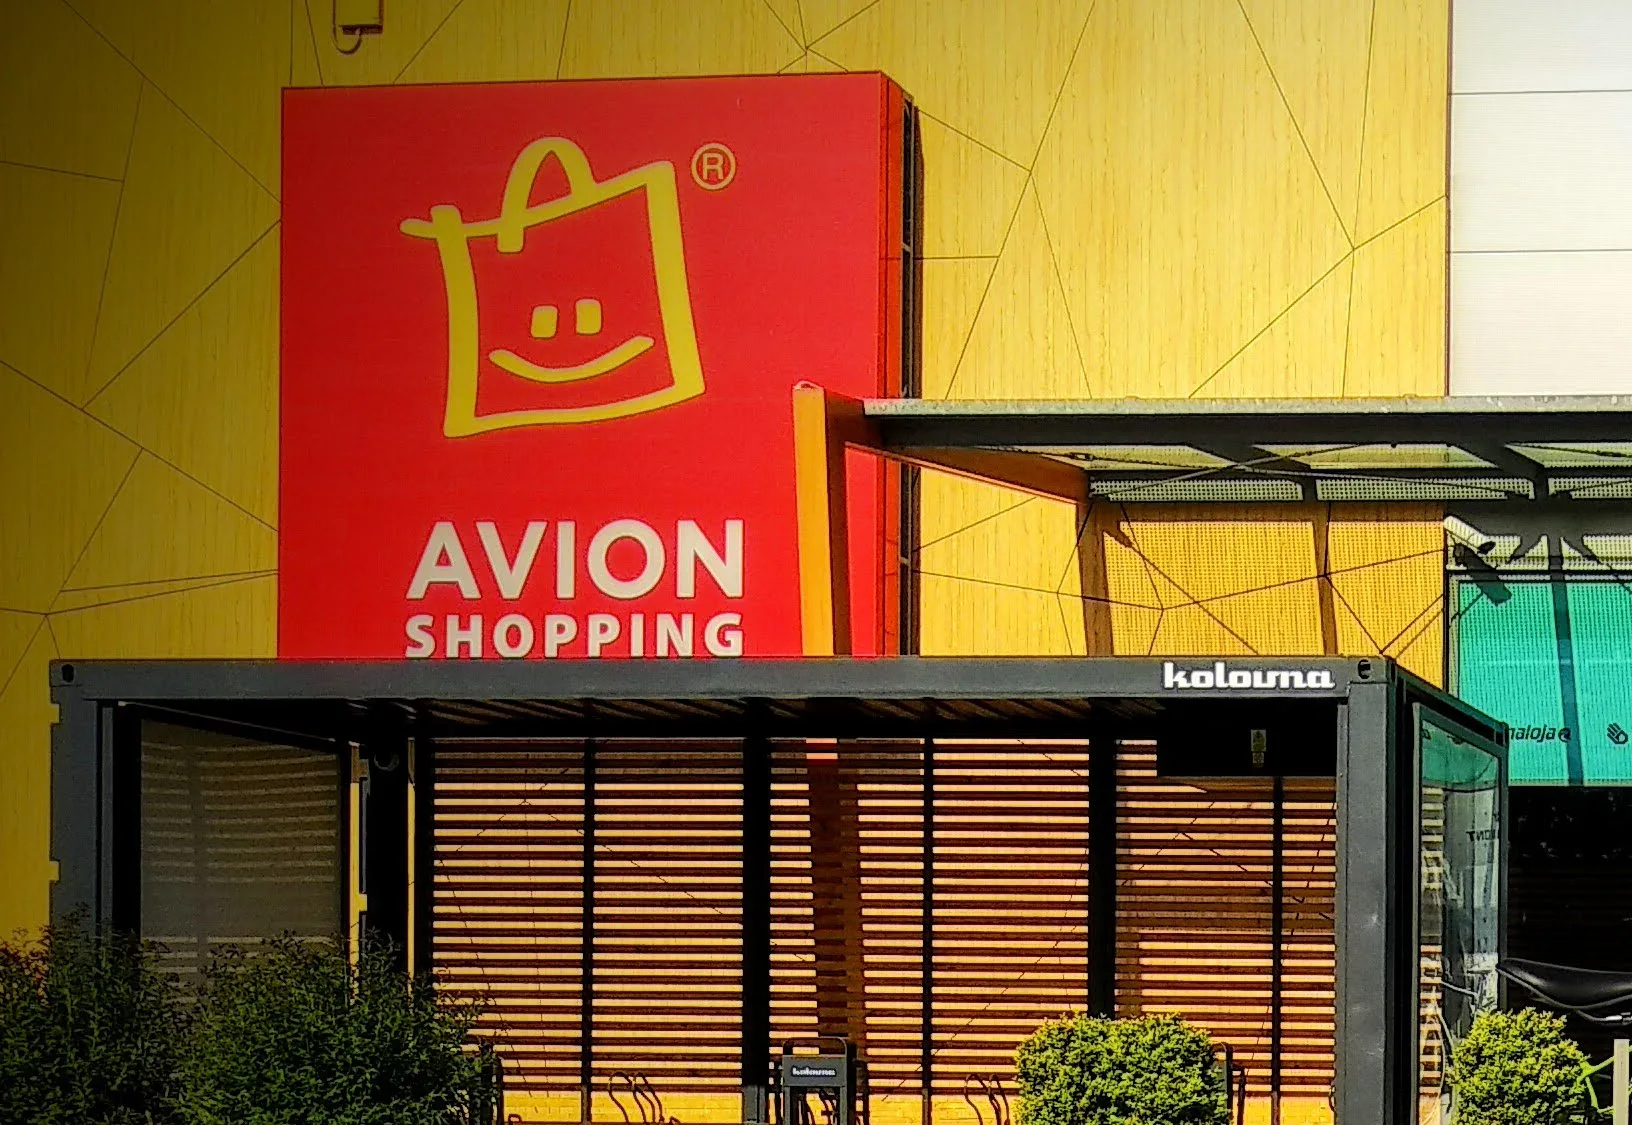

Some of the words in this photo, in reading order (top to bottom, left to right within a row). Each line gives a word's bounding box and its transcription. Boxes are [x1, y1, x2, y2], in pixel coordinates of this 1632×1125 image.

[405, 518, 744, 601] AVION
[404, 612, 745, 658] SHOPPING
[1163, 661, 1336, 689] kolovna
